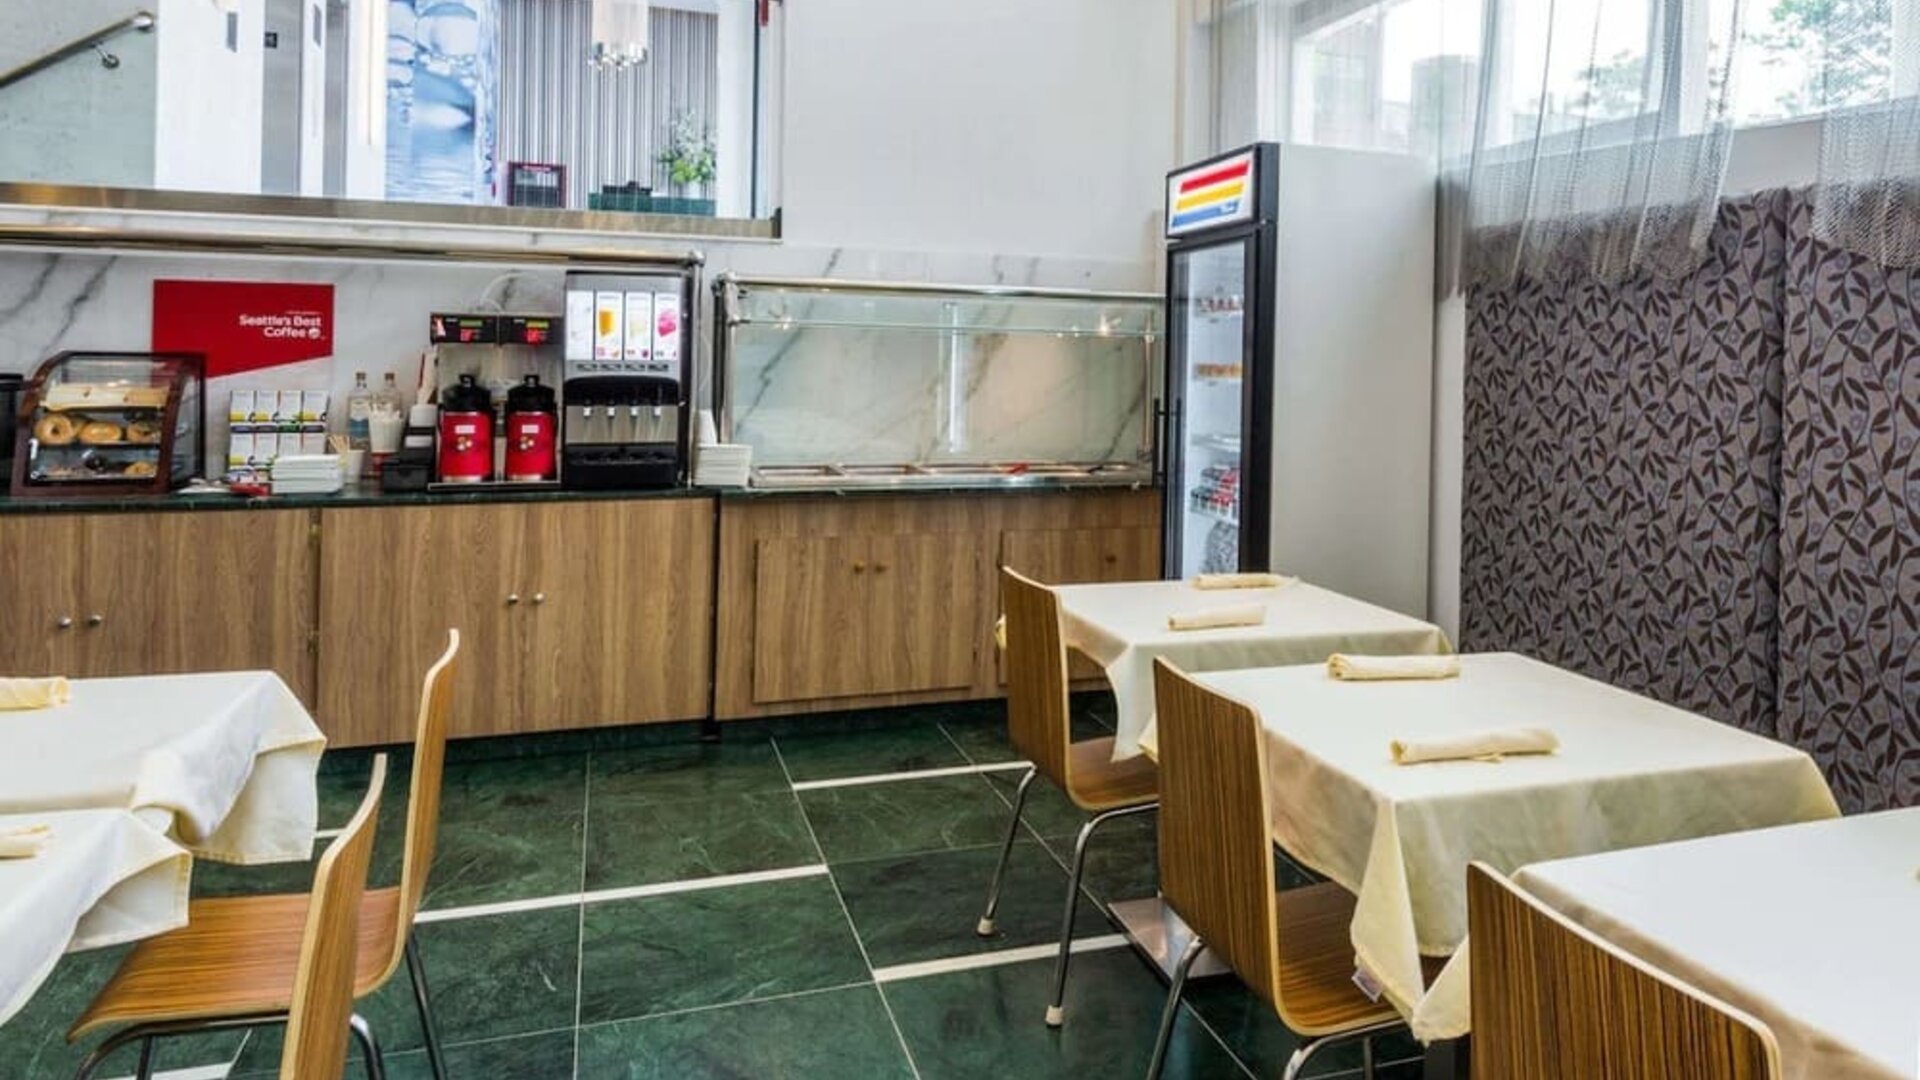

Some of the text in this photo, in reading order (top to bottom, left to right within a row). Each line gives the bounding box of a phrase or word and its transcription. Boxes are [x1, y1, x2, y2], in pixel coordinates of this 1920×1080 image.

[239, 314, 321, 326] Seattle's Best
[263, 327, 306, 338] Coffee
